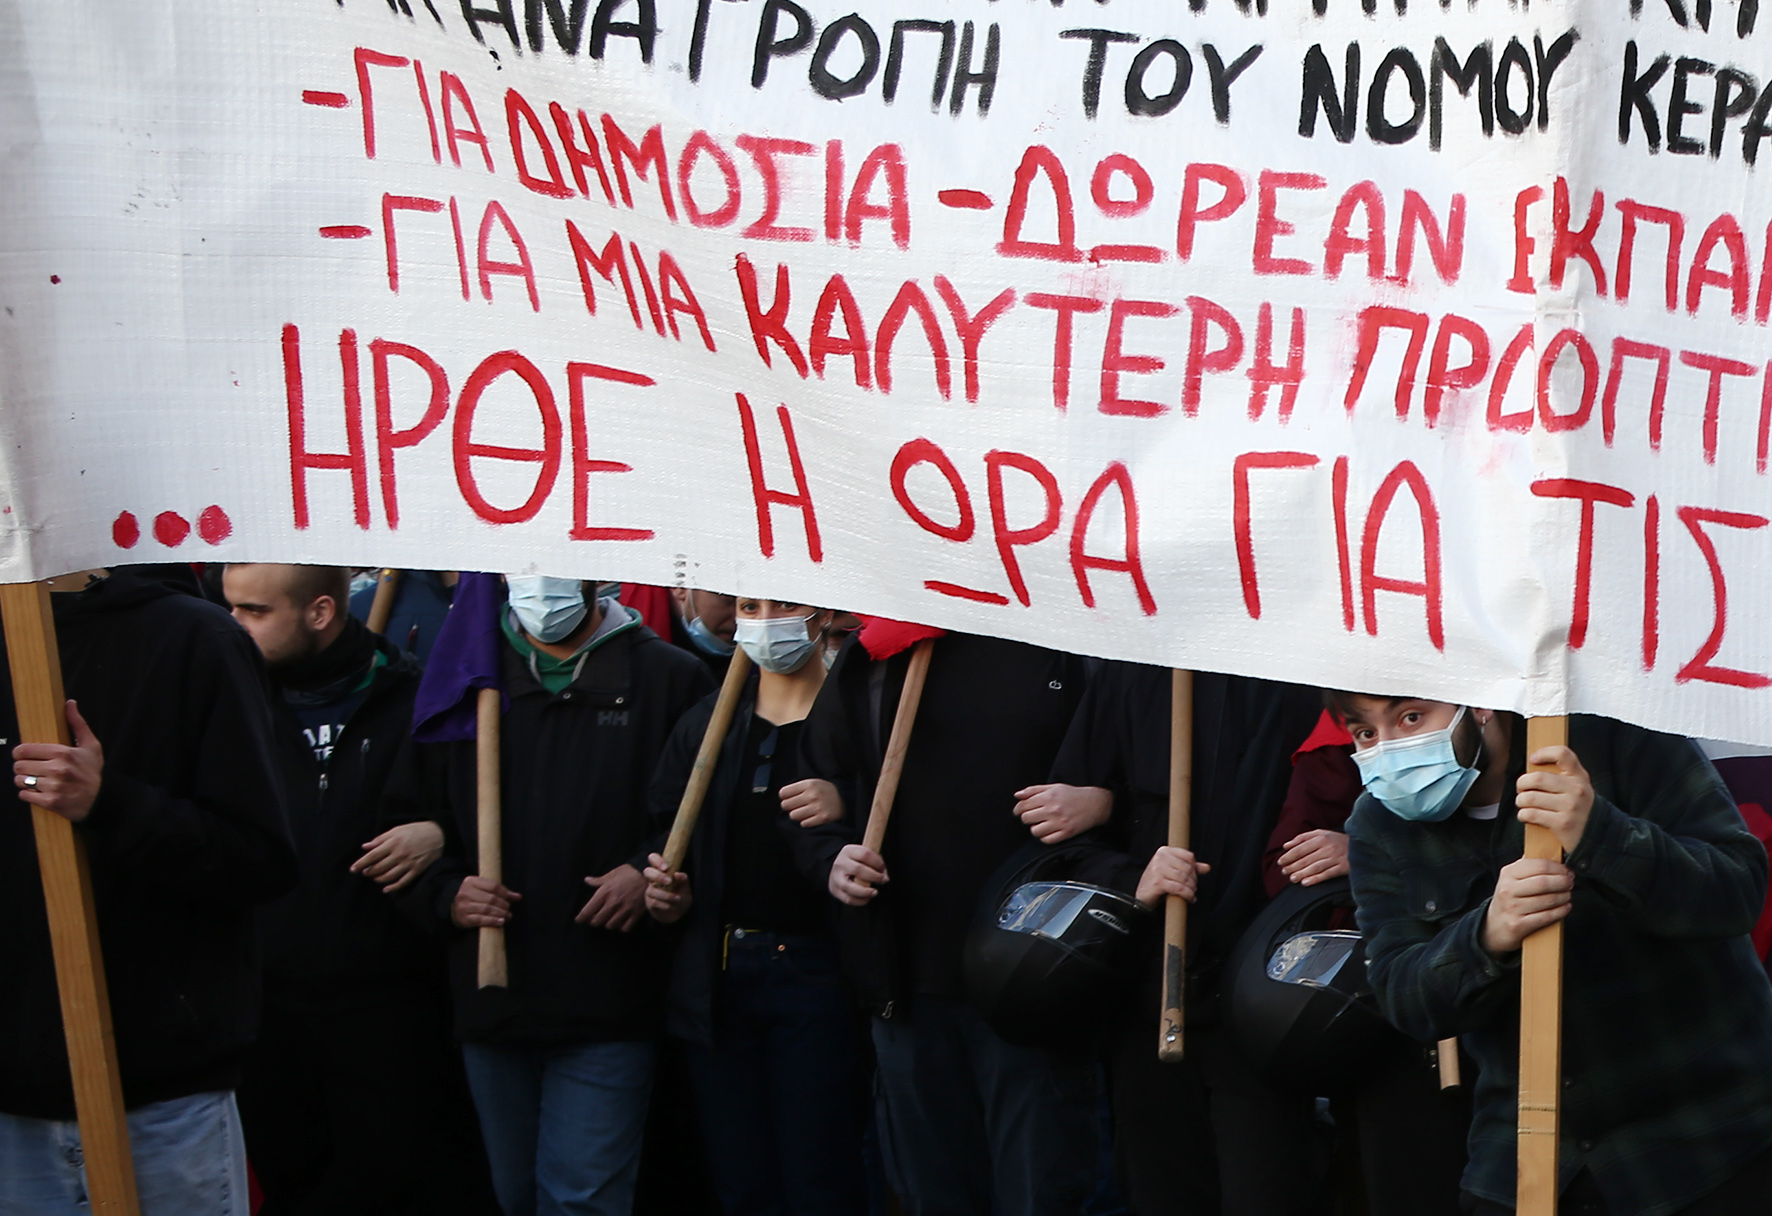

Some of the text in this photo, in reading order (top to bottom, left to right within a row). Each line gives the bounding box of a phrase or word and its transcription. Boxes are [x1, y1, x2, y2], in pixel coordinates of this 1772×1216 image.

[506, 86, 913, 250] ΔΗΜΟΣΙΑ
[1058, 28, 1264, 126] ΤΟΥ
[1298, 27, 1582, 152] ΝΟΜΟΥ
[565, 218, 717, 353] ΜΙΑ
[734, 250, 1307, 424] ΚΑΛΥΤΕΡΗ
[281, 323, 657, 543] ΗΡΘΕ
[735, 392, 823, 564] Η
[889, 437, 1158, 616] ΩΡΑ
[1232, 450, 1446, 655] ΓΙΑ
